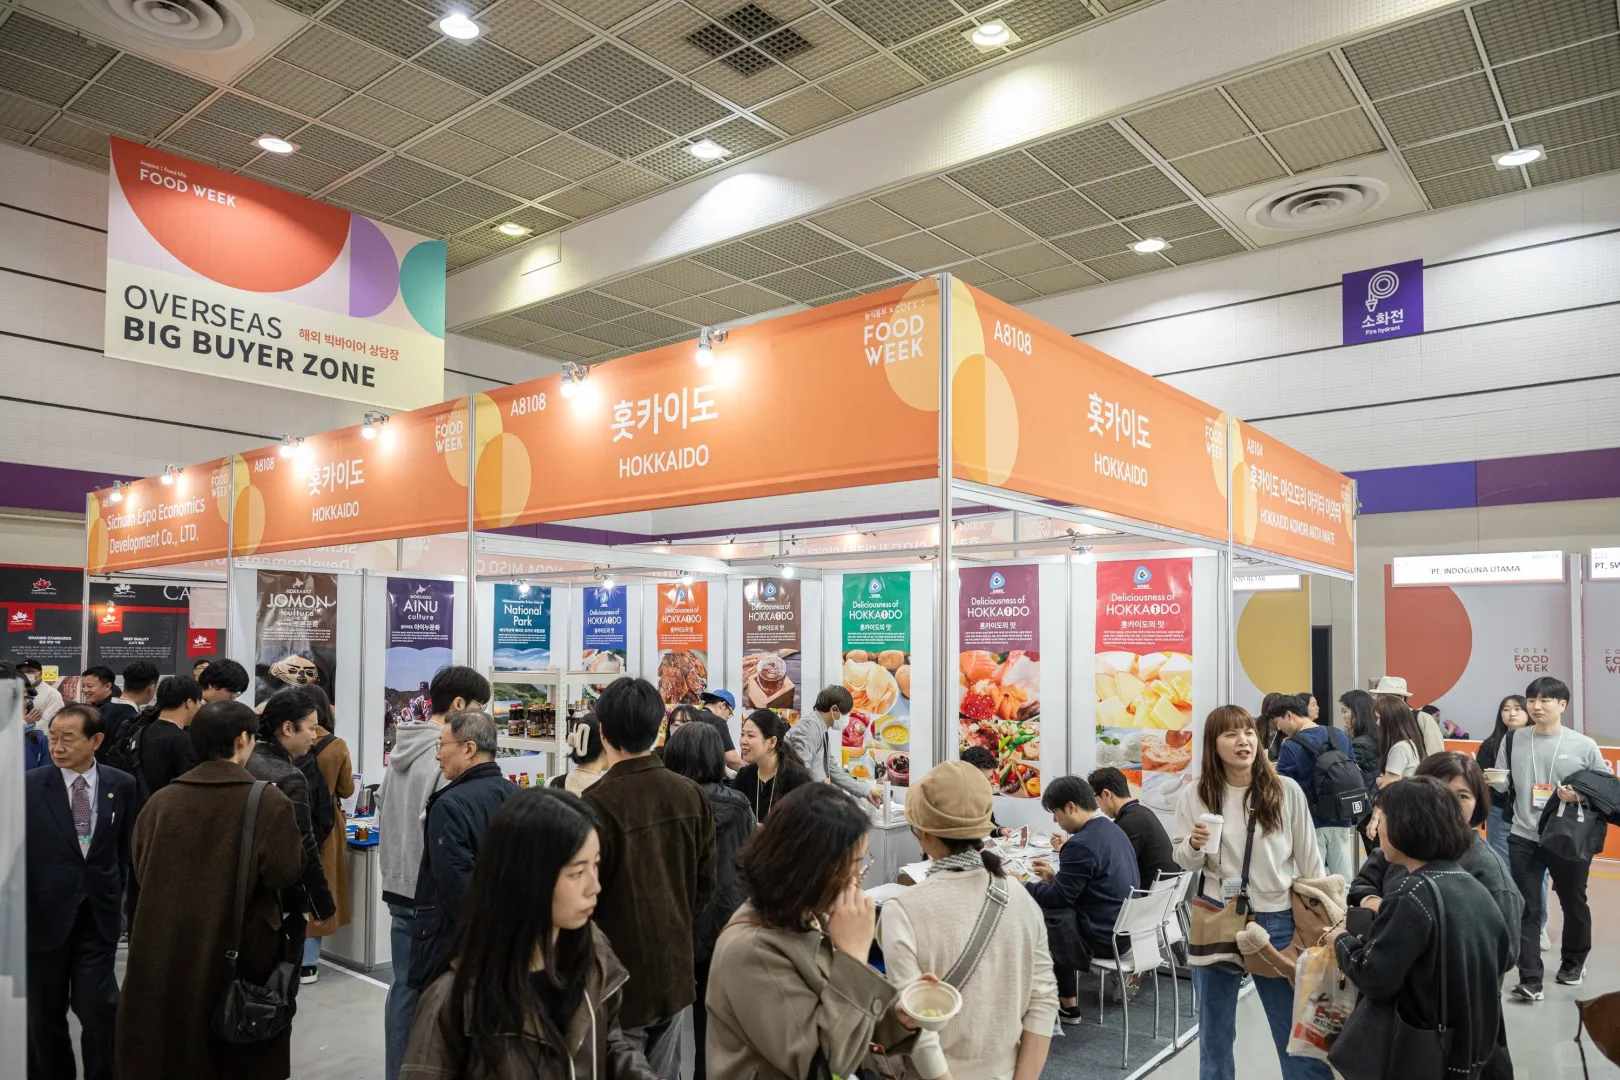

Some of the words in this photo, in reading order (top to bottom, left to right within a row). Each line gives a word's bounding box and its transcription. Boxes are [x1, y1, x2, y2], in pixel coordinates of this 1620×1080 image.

[140, 168, 188, 193] FOOD
[192, 184, 237, 208] WEEK
[124, 285, 282, 340] OVERSEAS
[895, 300, 918, 313] COEX
[1361, 309, 1404, 329] 소화전
[864, 314, 925, 346] FOOD
[993, 319, 1032, 356] A8108
[1377, 325, 1401, 335] hydrant
[124, 315, 181, 349] BIG
[192, 330, 294, 373] BUYER
[302, 353, 376, 388] ZONE
[298, 328, 321, 344] 해외
[324, 333, 366, 354] 빅바이어
[369, 344, 400, 361] 상담장
[864, 336, 924, 367] WEEK
[510, 393, 547, 417] A8108
[610, 385, 719, 443] 홋카이도
[435, 420, 463, 439] FOOD
[1087, 392, 1152, 450] 홋카이도
[435, 435, 463, 454] WEEK
[1205, 425, 1223, 445] FOOD
[1205, 440, 1224, 460] WEEK
[1246, 438, 1264, 459] A8104
[254, 457, 276, 474] A8108
[619, 444, 709, 479] HOKKAIDO
[1093, 452, 1148, 488] HOKKAIDO
[211, 473, 229, 487] FOOD
[308, 458, 365, 496] 홋카이도
[211, 486, 229, 499] WEEK
[1249, 463, 1280, 498] 홋카이도
[1280, 478, 1307, 511] 아오모리
[107, 511, 136, 532] Sichuan
[137, 508, 157, 527] Expo
[158, 495, 206, 521] Economics
[312, 501, 360, 523] HOKKAIDO
[1260, 508, 1289, 531] HOKKAIDO
[1289, 517, 1309, 537] AOMORI
[109, 530, 160, 555] Development
[161, 529, 178, 547] Co.,
[180, 523, 199, 543] LTD.
[1444, 566, 1489, 575] INDOGUNA
[1490, 565, 1521, 573] UTAMA
[1594, 562, 1608, 570] PT.
[266, 593, 337, 610] JOMON
[852, 600, 892, 609] Deliciousness
[891, 599, 899, 608] of
[971, 596, 1017, 606] Deliciousness
[1017, 595, 1026, 604] of
[1111, 592, 1166, 602] Deliciousness
[1166, 590, 1176, 601] of
[281, 608, 314, 617] culture
[403, 599, 438, 613] AINU
[504, 604, 542, 616] National
[751, 603, 785, 611] Deliciousness
[784, 601, 791, 610] of
[407, 612, 434, 621] culture
[513, 615, 533, 627] Park
[979, 622, 1009, 630] 홋카이도의
[1010, 621, 1016, 630] 맛
[1120, 620, 1156, 629] 홋카이도의
[1157, 620, 1165, 629] 맛
[1514, 655, 1549, 664] FOOD
[1515, 663, 1548, 673] WEEK
